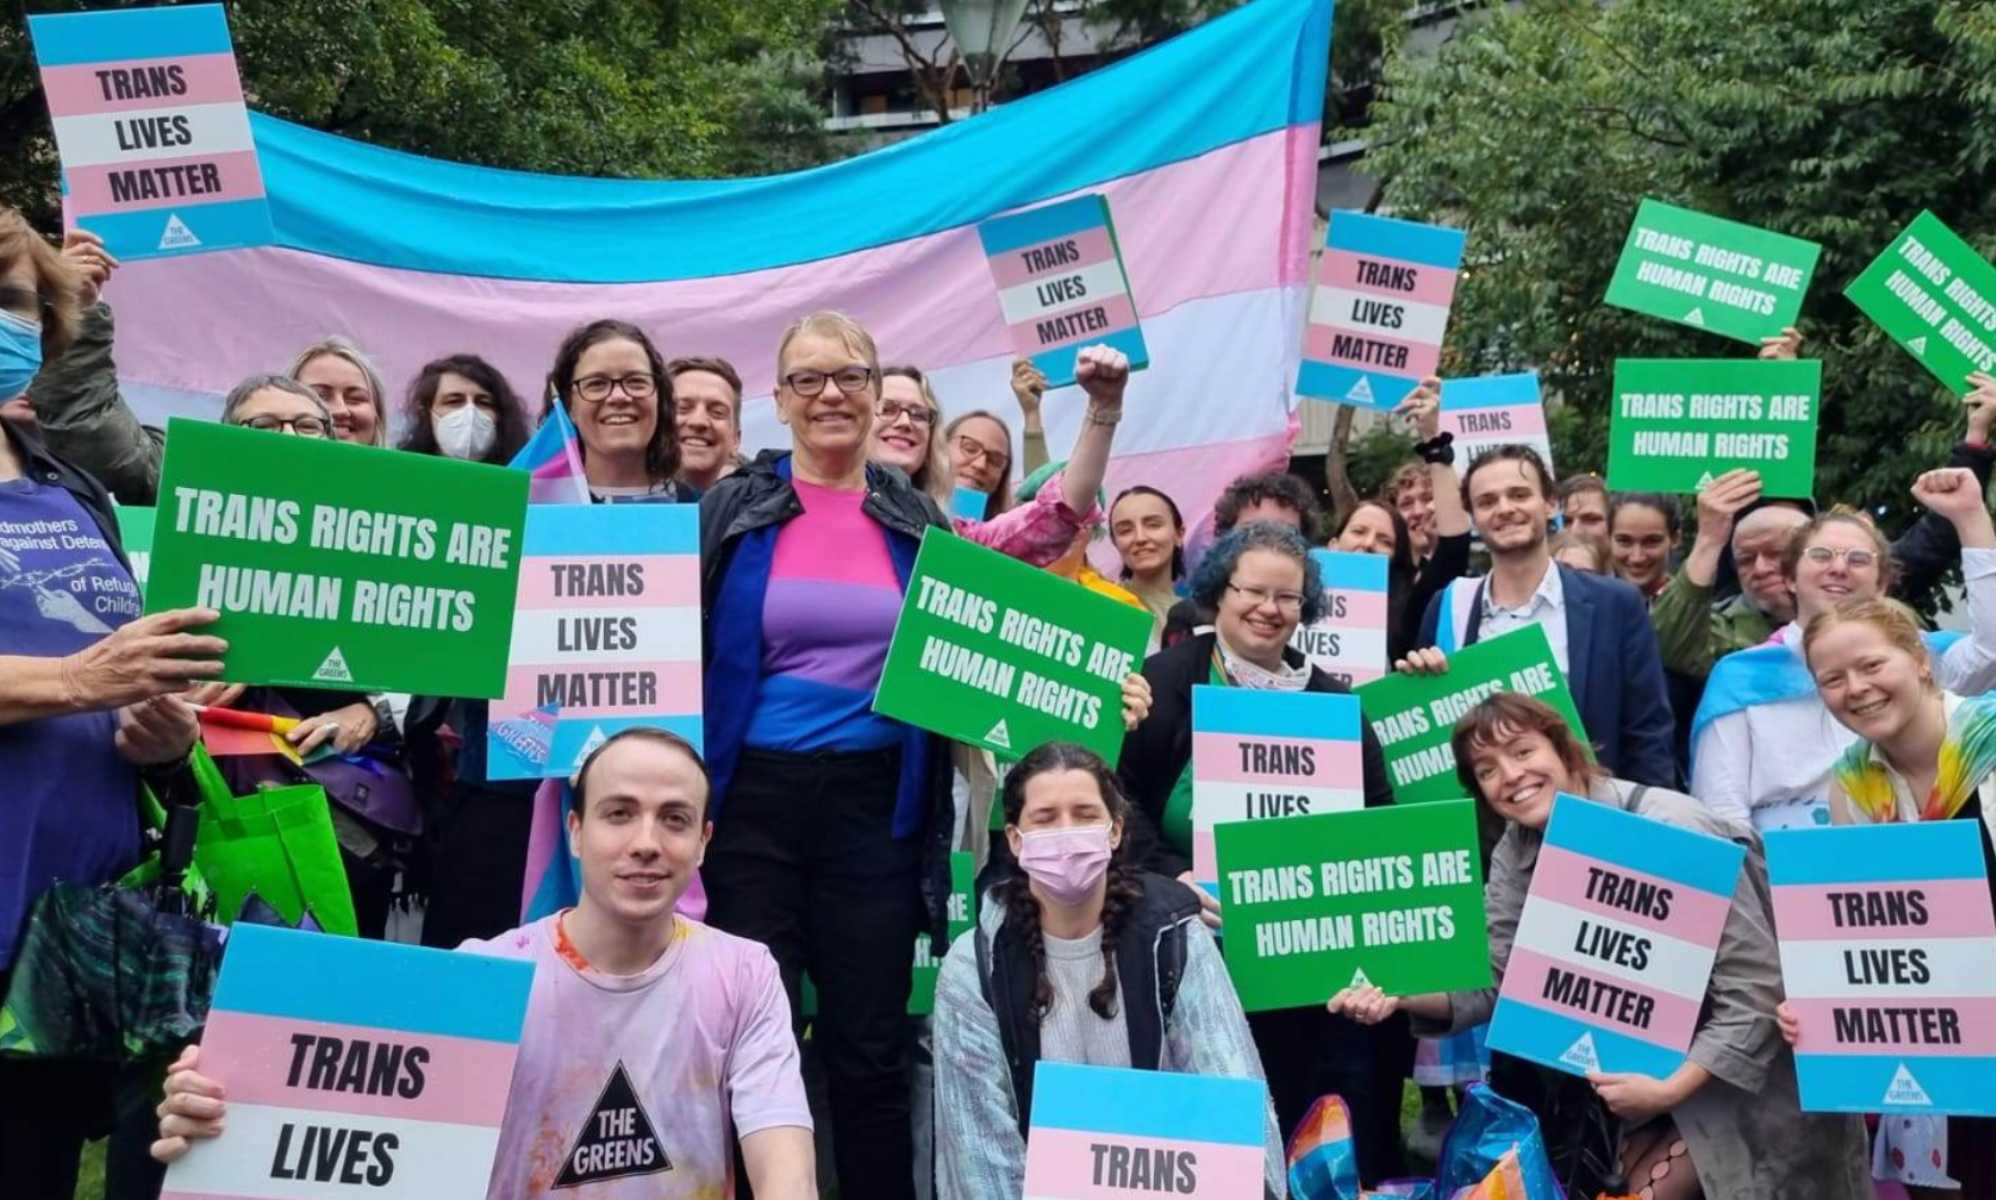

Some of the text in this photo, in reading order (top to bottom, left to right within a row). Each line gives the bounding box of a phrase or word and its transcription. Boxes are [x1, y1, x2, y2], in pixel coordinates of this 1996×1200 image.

[95, 64, 188, 101] TRANS
[114, 115, 192, 151] LIVES
[108, 163, 222, 202] MATTER
[1022, 240, 1080, 274] TRANS
[1634, 227, 1804, 290] TRANS RIGHTS ARE
[1898, 235, 1952, 286] TRANS
[1036, 275, 1087, 307] LIVES
[1357, 260, 1417, 292] TRANS
[1636, 260, 1777, 316] HUMAN RIGHTS
[1036, 306, 1109, 345] MATTER
[1351, 298, 1404, 329] LIVES
[1884, 269, 1996, 372] HUMAN RIGHTS
[1331, 334, 1409, 369] MATTER
[1457, 411, 1512, 434] TRANS
[1620, 393, 1811, 421] TRANS RIGHTS ARE
[1633, 431, 1789, 460] HUMAN RIGHTS
[0, 520, 78, 535] dmothers
[175, 486, 512, 569] TRANS RIGHTS ARE
[71, 577, 87, 592] of
[198, 563, 342, 621] HUMAN
[352, 580, 476, 632] RIGHTS
[550, 563, 645, 597] TRANS
[557, 617, 638, 652] LIVES
[917, 575, 1135, 685] TRANS RIGHTS ARE
[1297, 631, 1340, 657] IVES
[537, 671, 657, 708] MATTER
[919, 635, 1103, 730] HUMAN RIGHTS
[1371, 706, 1430, 747] RANS
[1509, 662, 1556, 697] ARE
[1239, 742, 1316, 776] TRANS
[1391, 742, 1457, 787] HUMA
[1228, 850, 1473, 905] TRANS RIGHTS ARE
[1585, 866, 1674, 921] TRANS
[1827, 890, 1929, 928] TRANS
[1256, 905, 1456, 957] HUMAN RIGHTS
[1574, 920, 1652, 971] LIVES
[1844, 949, 1930, 985] LIVES
[1542, 966, 1655, 1030] MATTER
[1832, 1007, 1962, 1044] MATTER
[286, 1033, 430, 1100] TRANS
[598, 1107, 636, 1138] THE
[270, 1123, 399, 1188] LIVES
[573, 1137, 655, 1172] GREENS
[1090, 1143, 1197, 1195] TRANS
